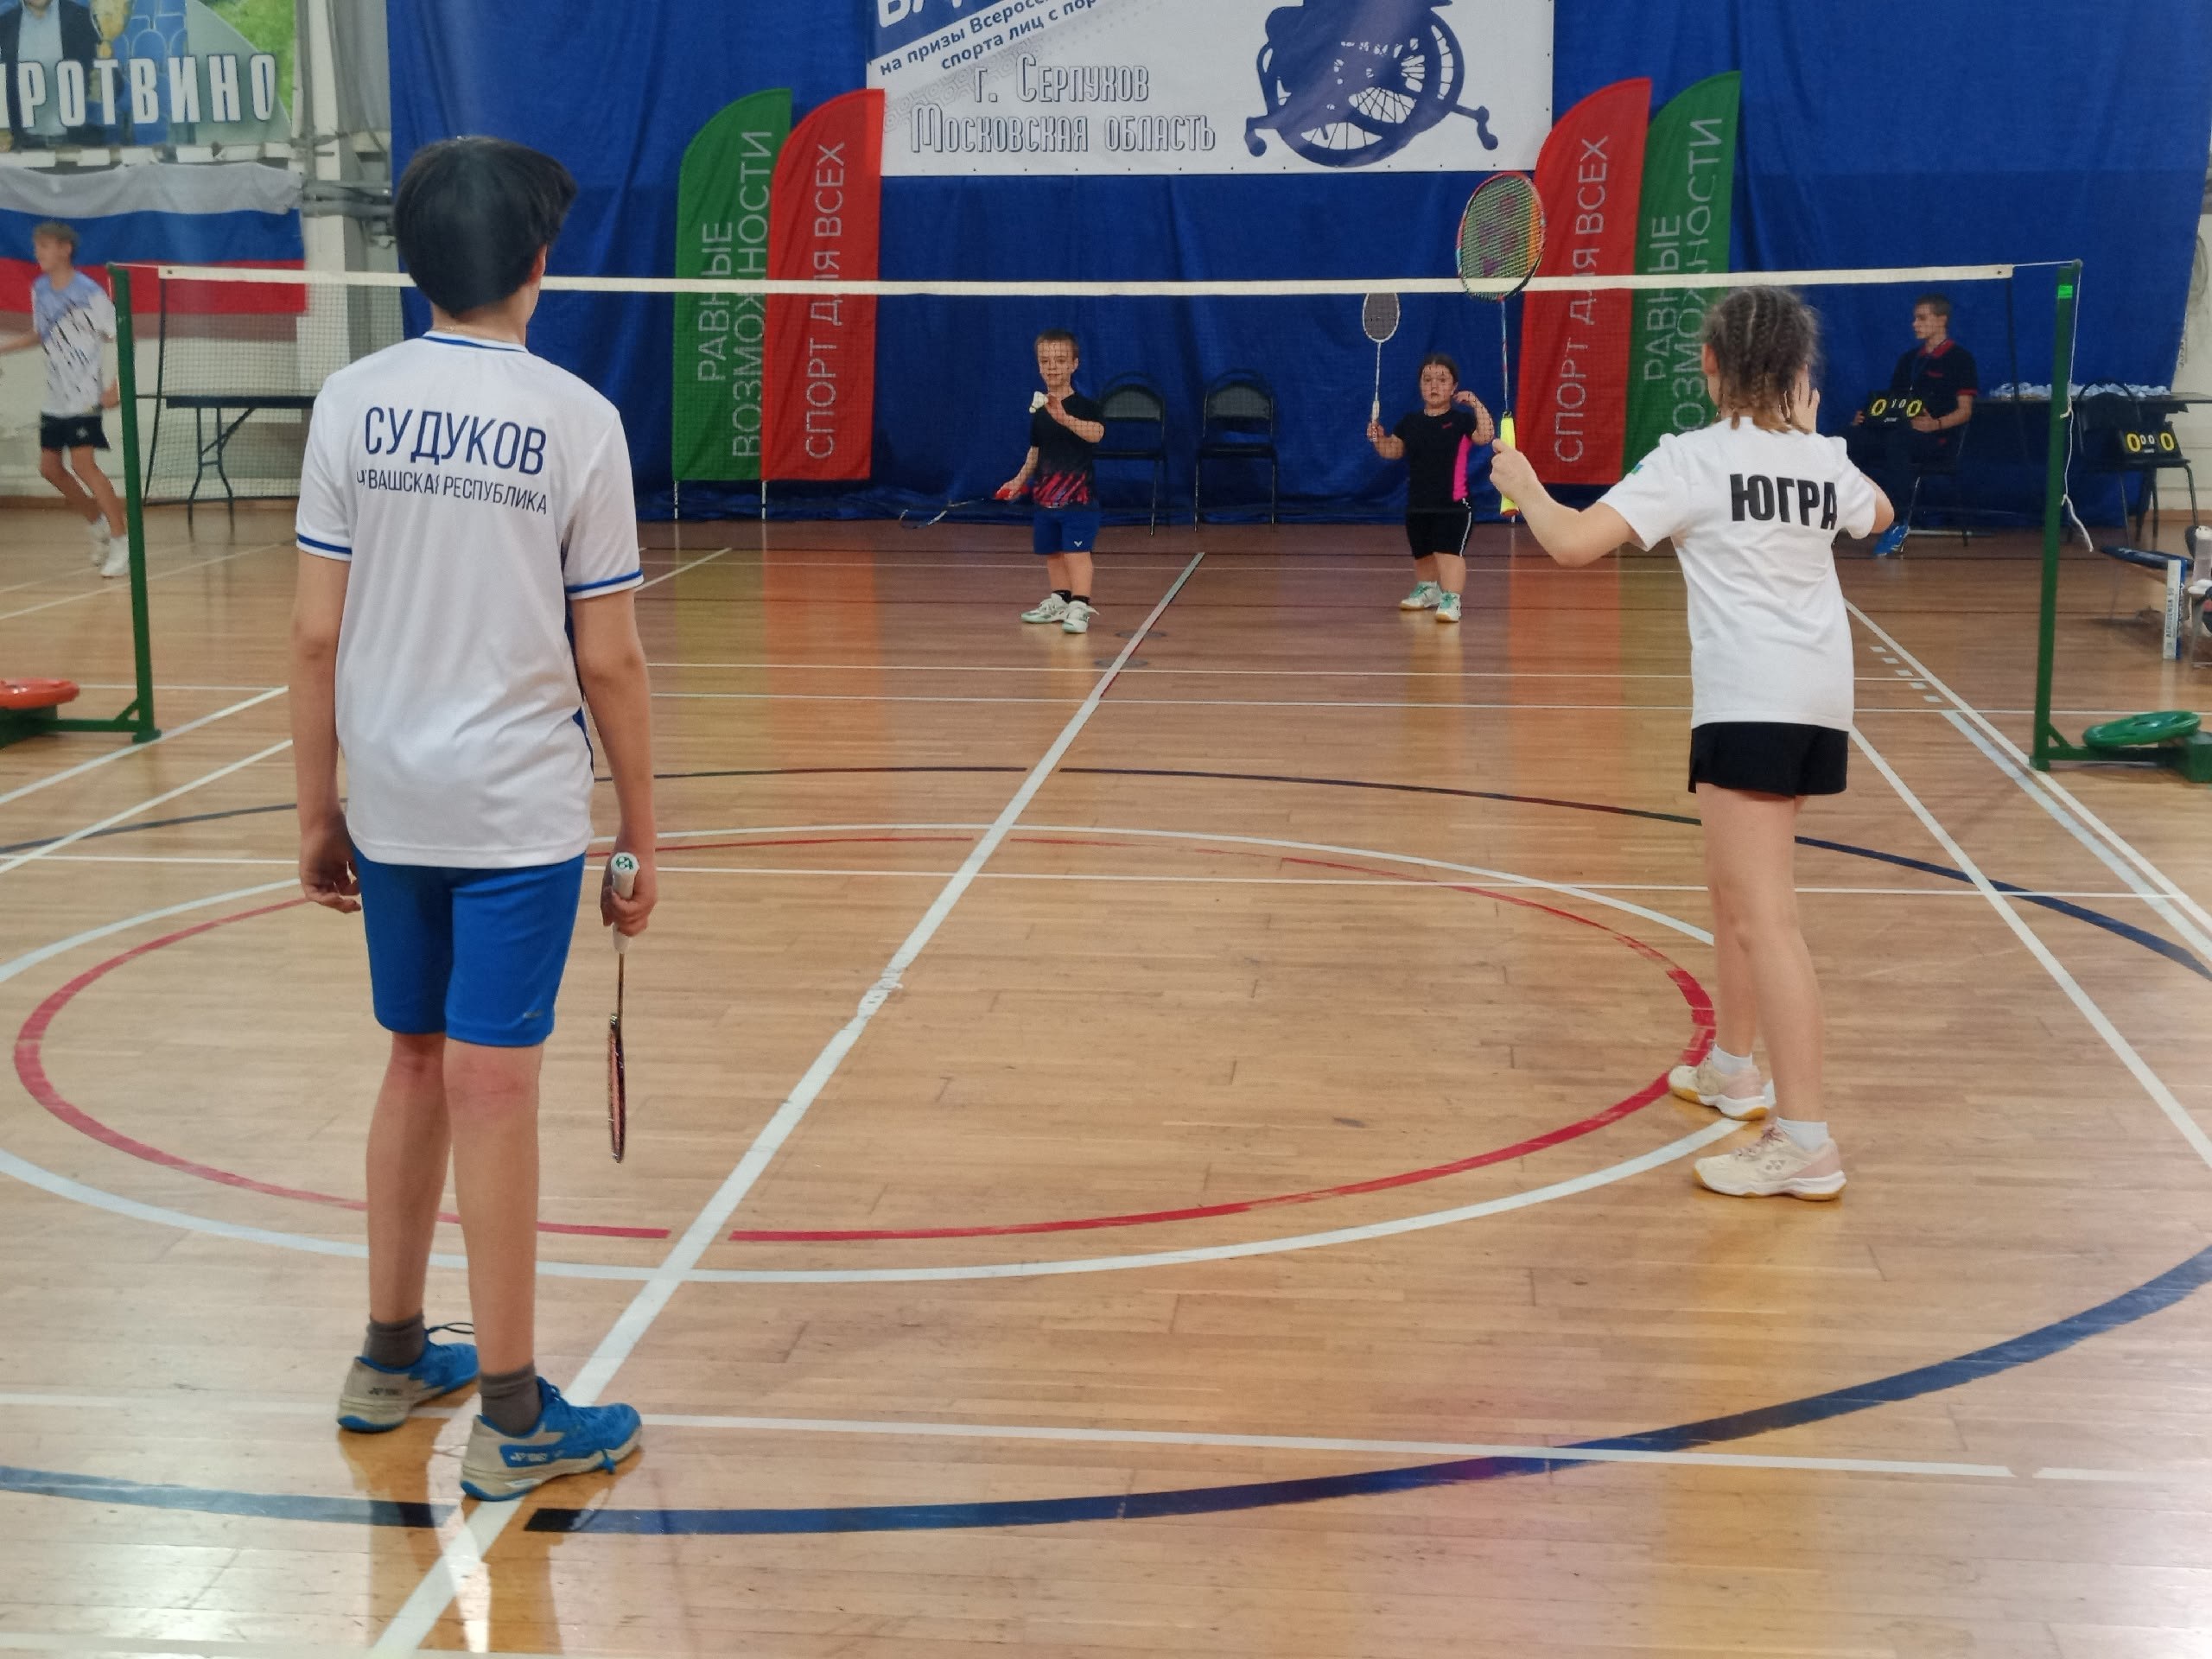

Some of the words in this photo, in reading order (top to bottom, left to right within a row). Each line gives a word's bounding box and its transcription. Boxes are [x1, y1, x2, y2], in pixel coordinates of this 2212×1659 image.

[880, 58, 903, 76] на
[907, 29, 966, 63] призы
[941, 35, 1003, 70] спорта
[1009, 16, 1045, 41] лиц
[1048, 9, 1058, 21] с
[0, 54, 276, 129] РОТВИНО
[814, 142, 845, 237] ВСЕХ
[1555, 337, 1588, 462] СПОРТ
[1575, 136, 1609, 235] ВСЕХ
[805, 338, 837, 460] СПОРТ
[364, 406, 547, 476] СУДУКОВ
[355, 468, 441, 496] ЧВАШСКА
[443, 475, 548, 516] РЕСПУБЛИКА
[1729, 473, 1838, 531] ЮГРА
